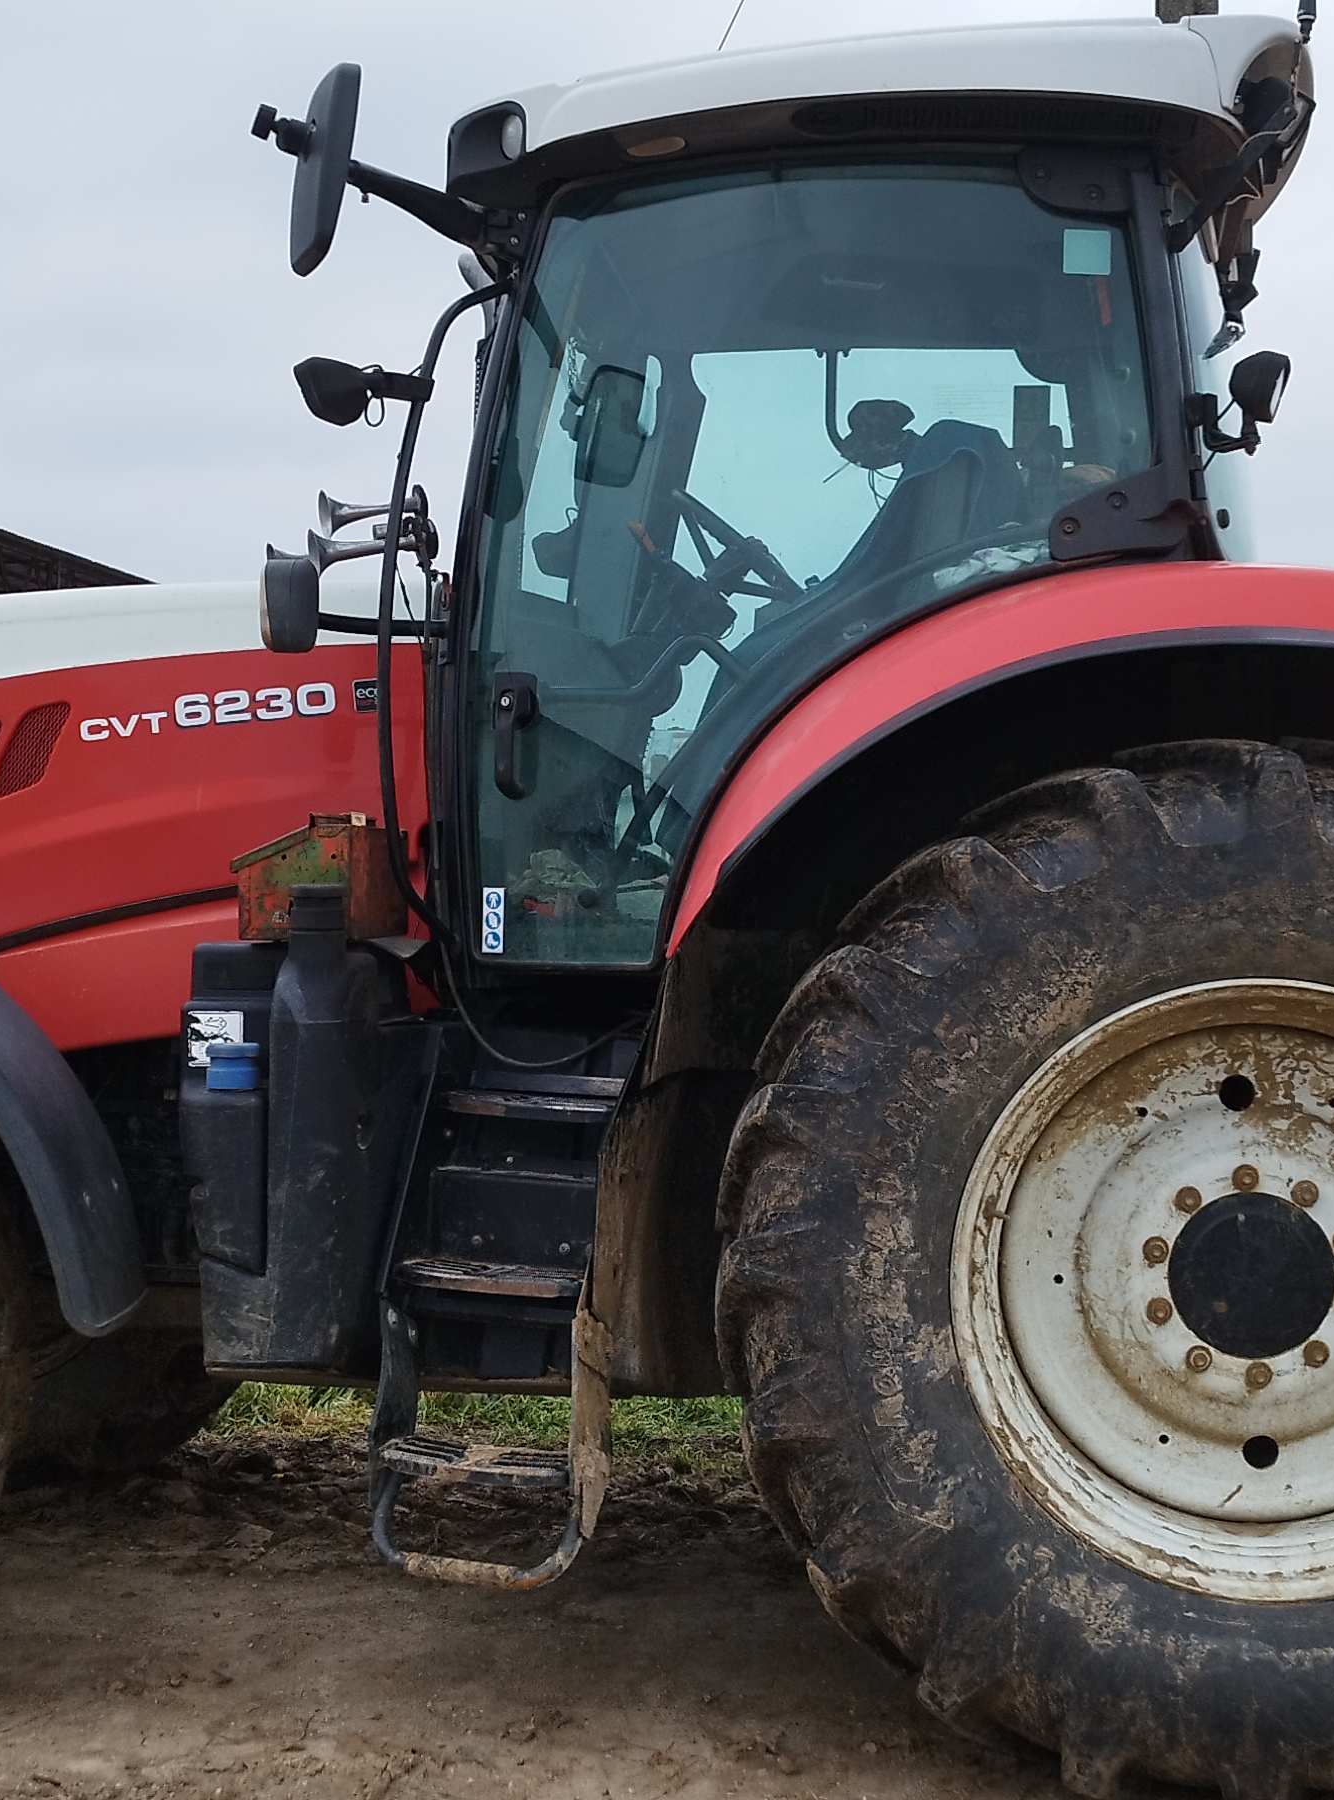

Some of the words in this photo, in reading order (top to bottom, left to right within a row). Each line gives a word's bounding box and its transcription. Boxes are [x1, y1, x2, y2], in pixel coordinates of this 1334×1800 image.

[355, 687, 378, 699] ec
[79, 711, 168, 741] CVT
[174, 682, 337, 729] 6230
